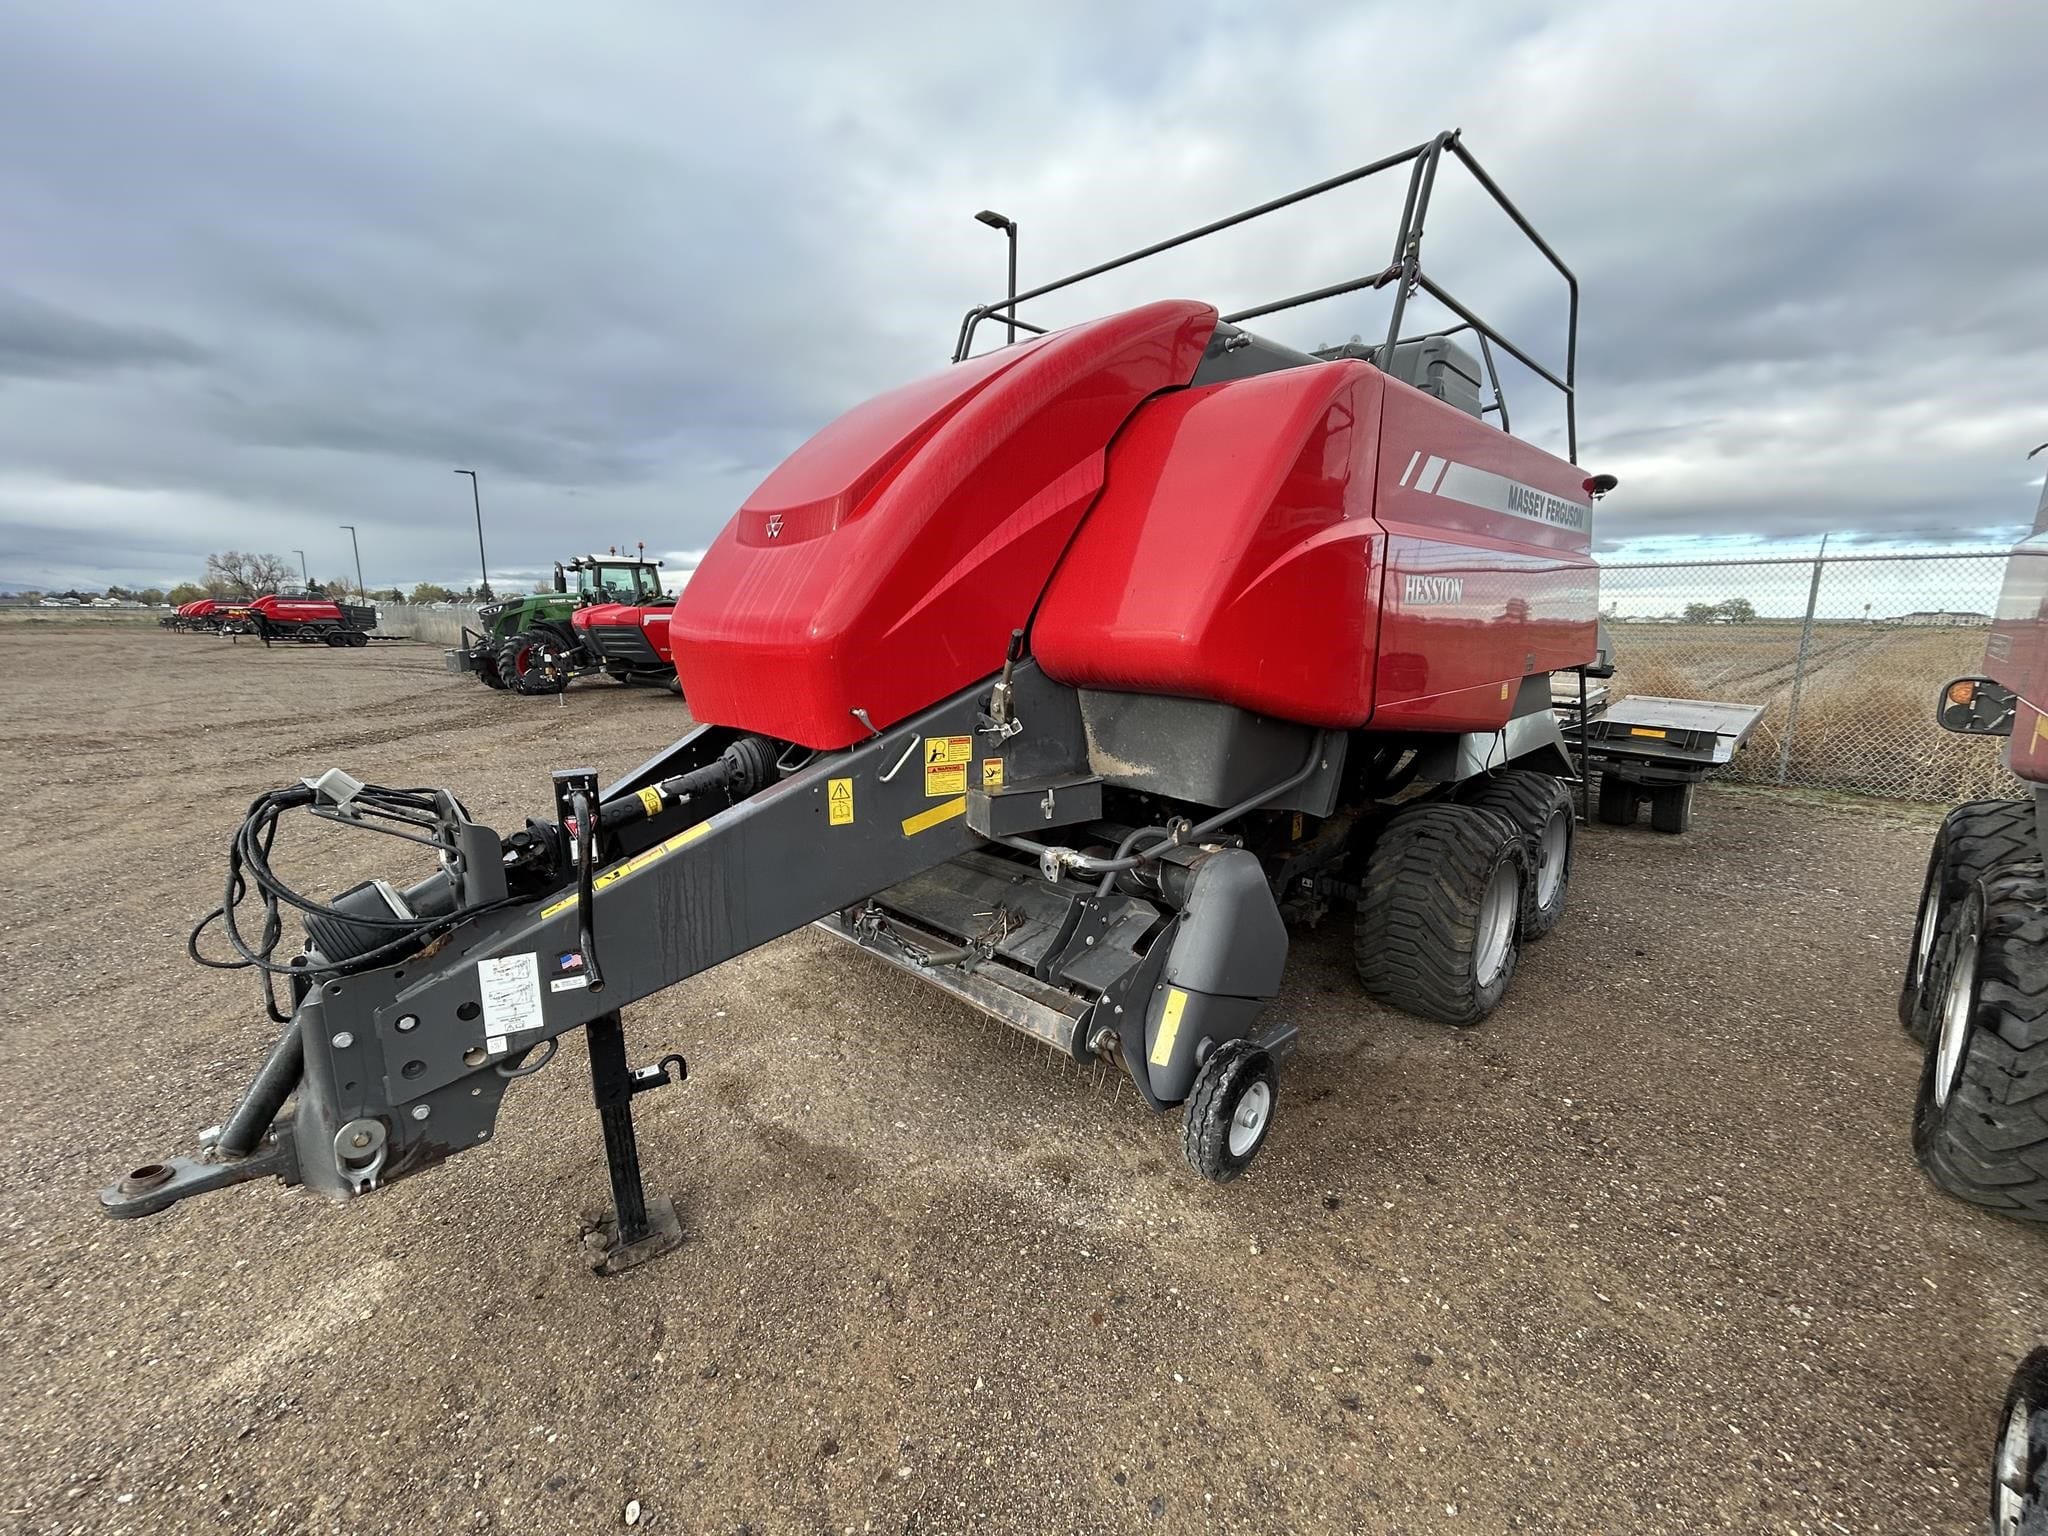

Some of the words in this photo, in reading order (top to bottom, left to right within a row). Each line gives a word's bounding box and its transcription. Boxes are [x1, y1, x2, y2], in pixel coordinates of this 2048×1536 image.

[1508, 484, 1545, 519] MASSEY
[1546, 497, 1584, 528] FERGUSON
[1404, 575, 1464, 604] HESSTON
